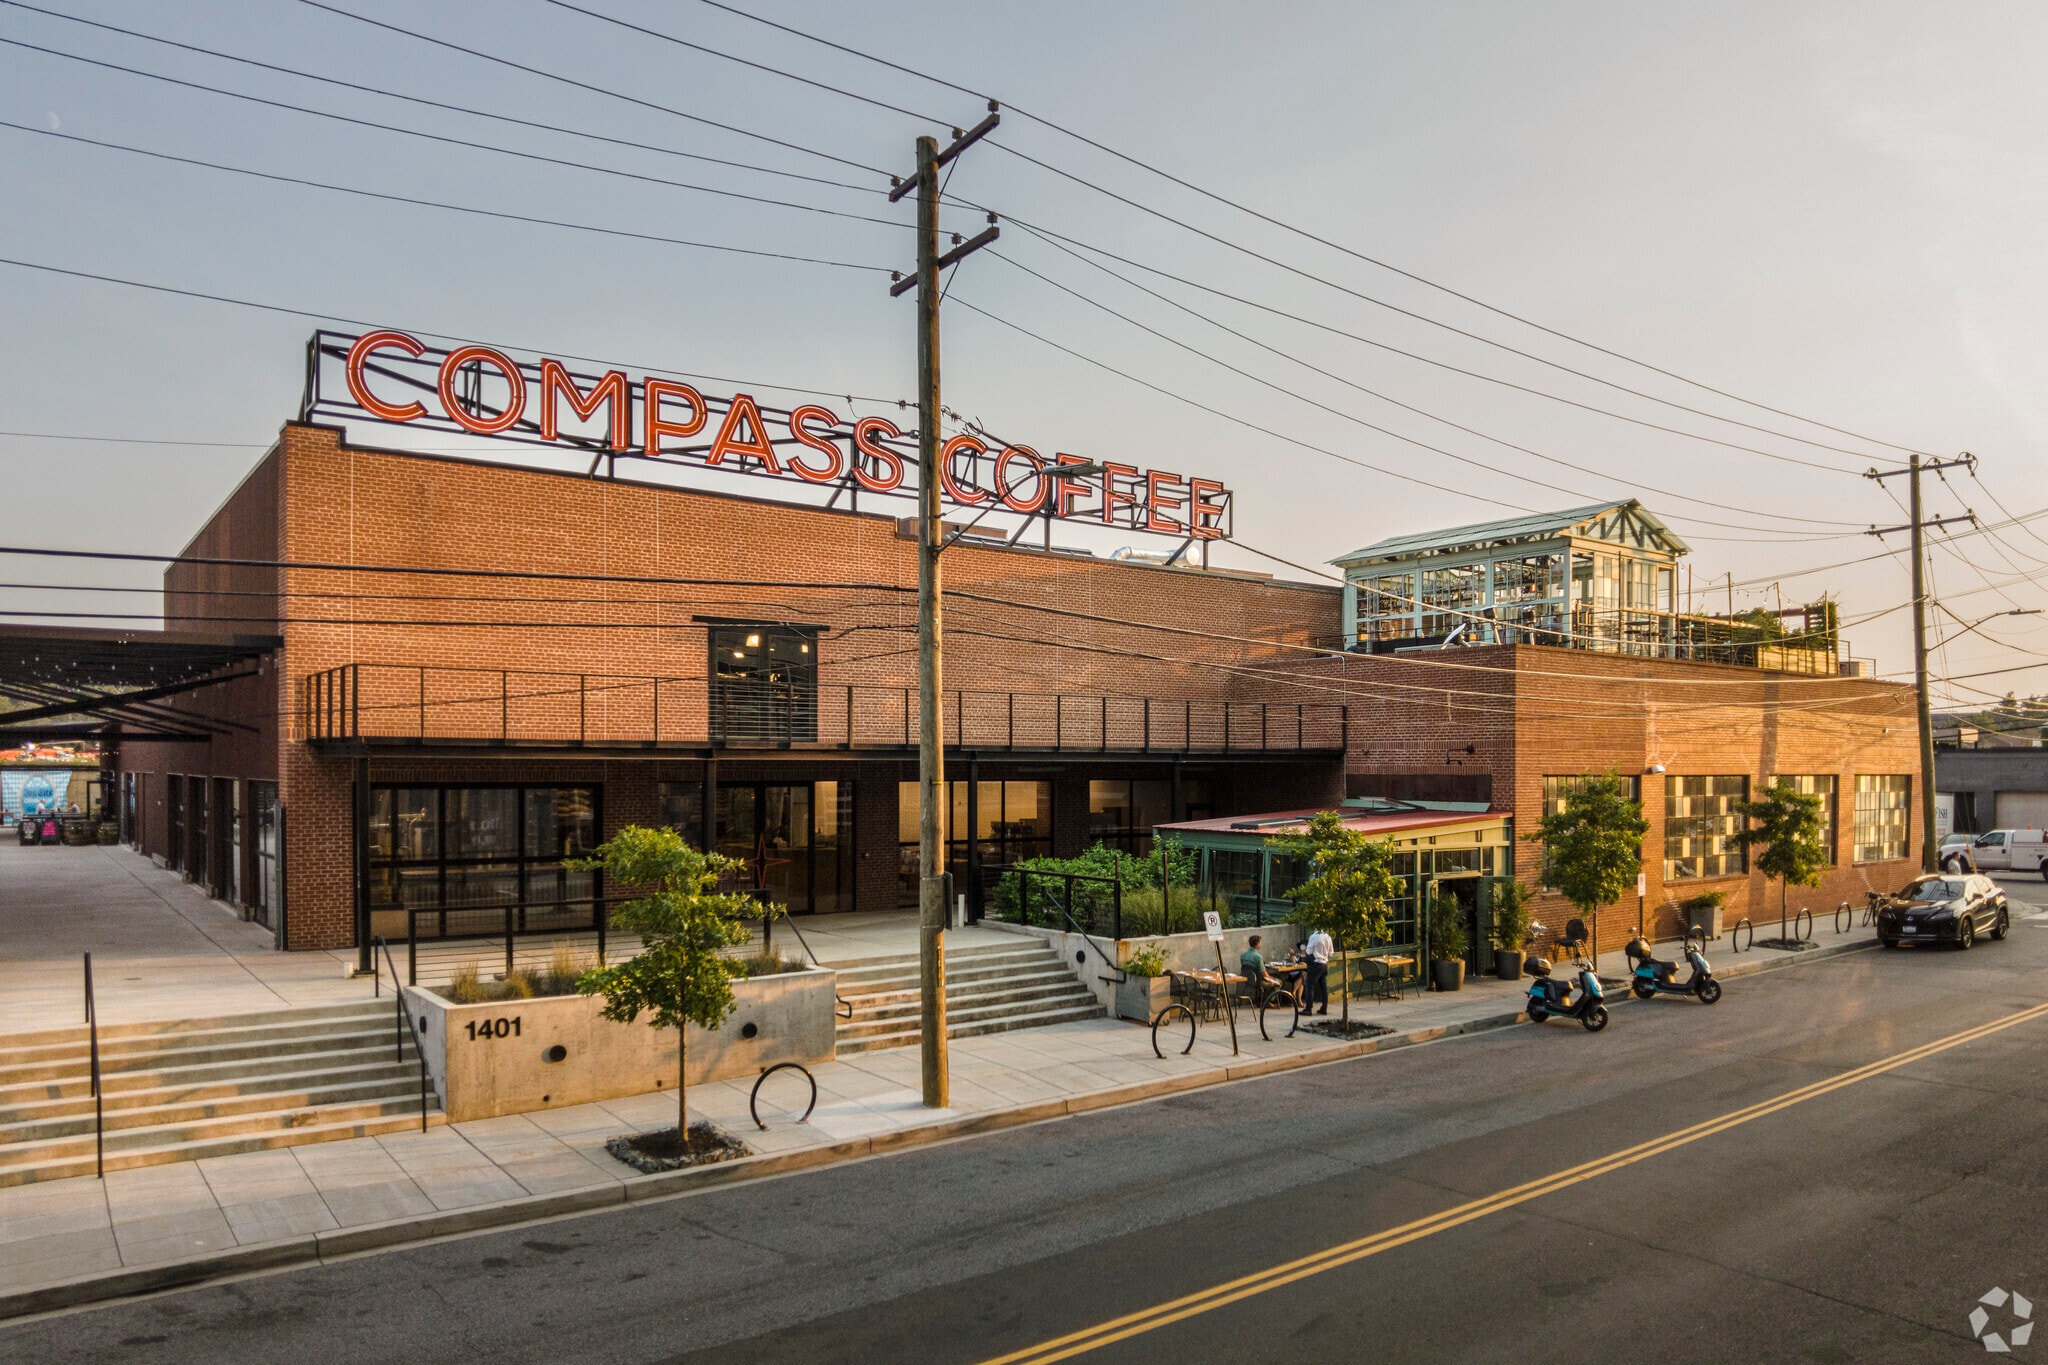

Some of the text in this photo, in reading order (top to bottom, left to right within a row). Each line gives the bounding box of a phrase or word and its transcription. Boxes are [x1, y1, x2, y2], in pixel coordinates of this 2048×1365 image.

[345, 329, 1223, 539] COMPASS COFFEE
[464, 1016, 521, 1041] 1401
